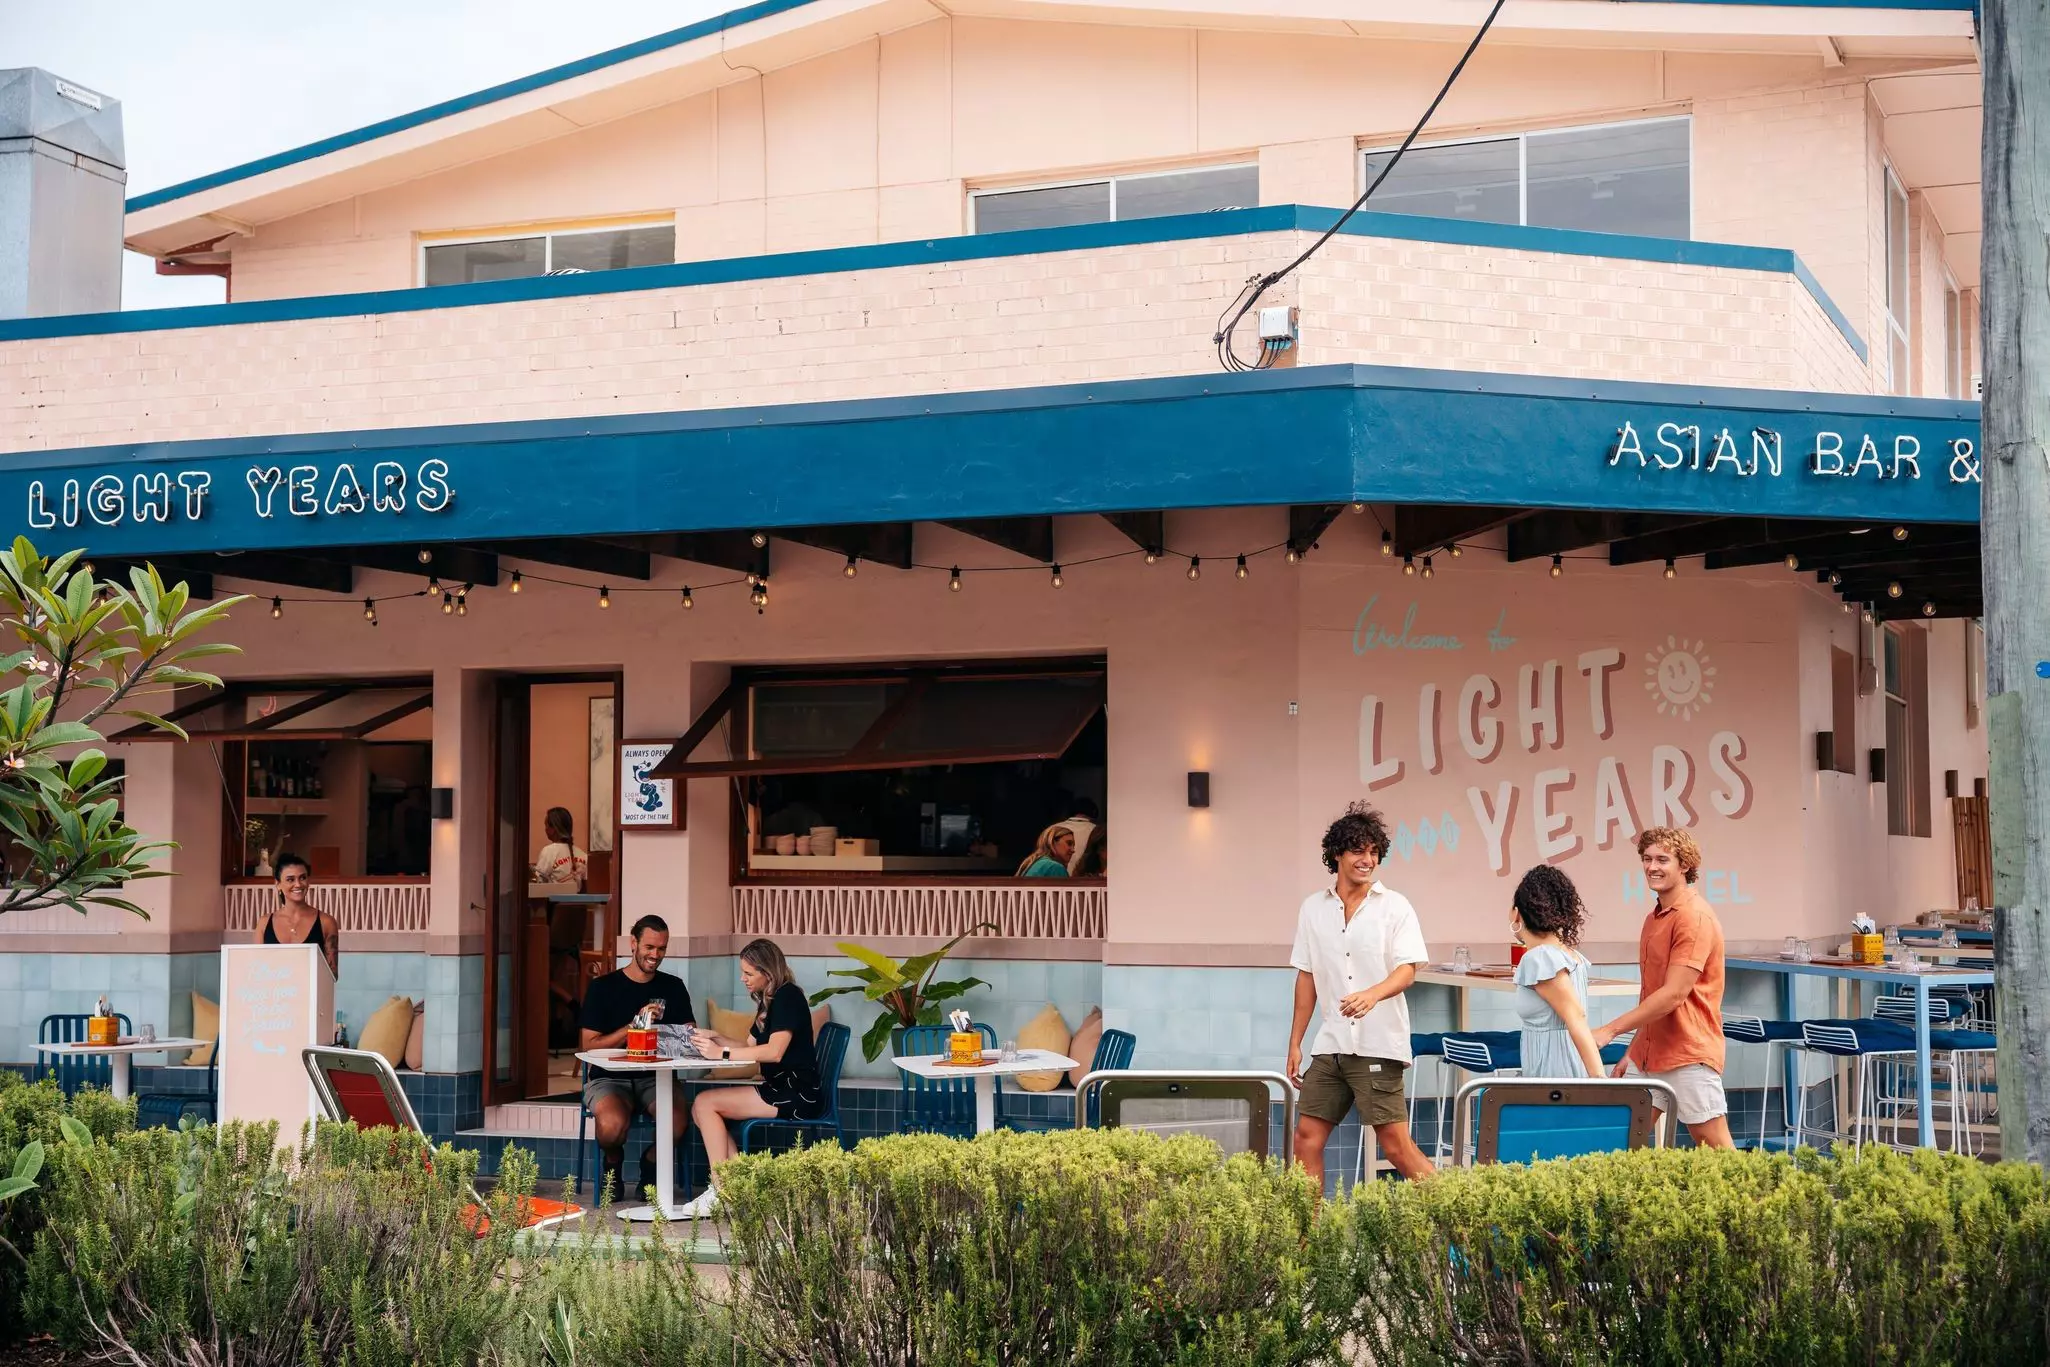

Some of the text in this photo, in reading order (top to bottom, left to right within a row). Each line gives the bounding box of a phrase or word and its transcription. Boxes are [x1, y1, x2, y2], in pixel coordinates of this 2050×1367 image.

[1608, 420, 1981, 484] ASIAN BAR &
[28, 458, 453, 529] LIGHT YEARS
[1352, 594, 1464, 656] Welcome
[1358, 647, 1626, 793] LIGHT
[624, 749, 649, 758] ALWAYS
[647, 813, 657, 821] THE
[1466, 730, 1754, 877] YEARS
[1622, 869, 1755, 905] HEL
